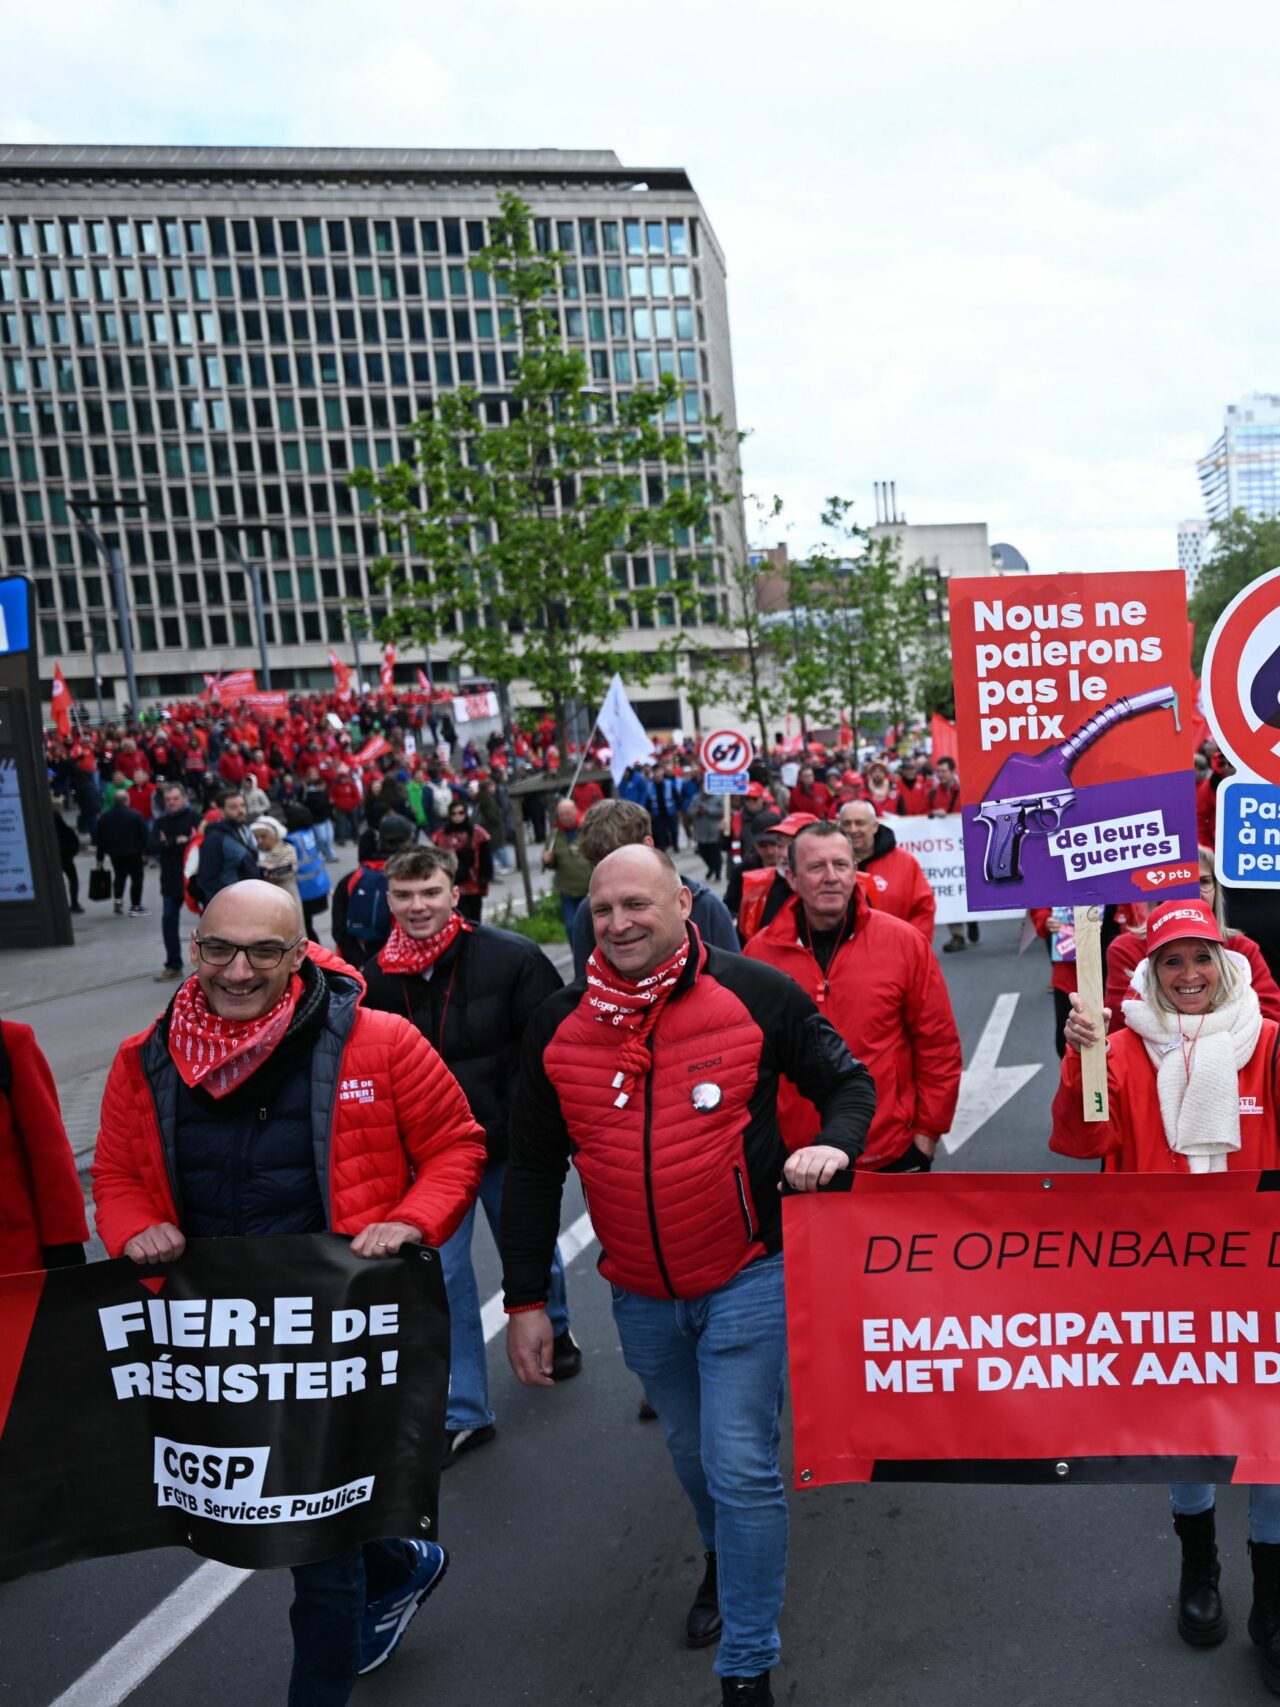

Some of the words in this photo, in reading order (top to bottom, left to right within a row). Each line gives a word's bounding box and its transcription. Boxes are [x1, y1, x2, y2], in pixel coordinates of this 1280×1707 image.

[973, 600, 1084, 632] Nous
[1095, 600, 1147, 627] ne
[976, 631, 1163, 678] paierons
[978, 677, 1058, 714] pas
[1069, 670, 1108, 702] le
[980, 705, 1066, 751] prix
[712, 744, 741, 762] 67
[900, 838, 954, 853] INOTS
[1056, 830, 1088, 849] de
[1094, 821, 1160, 844] leurs
[1238, 822, 1256, 845] à
[1070, 839, 1173, 872] guerres
[1168, 869, 1191, 881] ptb
[688, 1056, 722, 1073] acod
[863, 1234, 938, 1274] DE
[953, 1231, 1251, 1271] OPENBARE
[331, 1303, 399, 1343] DE
[862, 1311, 1196, 1352] EMANCIPATIE
[1210, 1310, 1261, 1344] IN
[111, 1354, 367, 1403] RÉSISTER
[864, 1359, 962, 1393] MET
[977, 1352, 1120, 1391] DANK
[1132, 1351, 1239, 1386] AAN
[163, 1446, 255, 1490] CGSP
[163, 1486, 198, 1512] FGTB
[204, 1499, 281, 1520] Services
[289, 1484, 368, 1518] Publics
